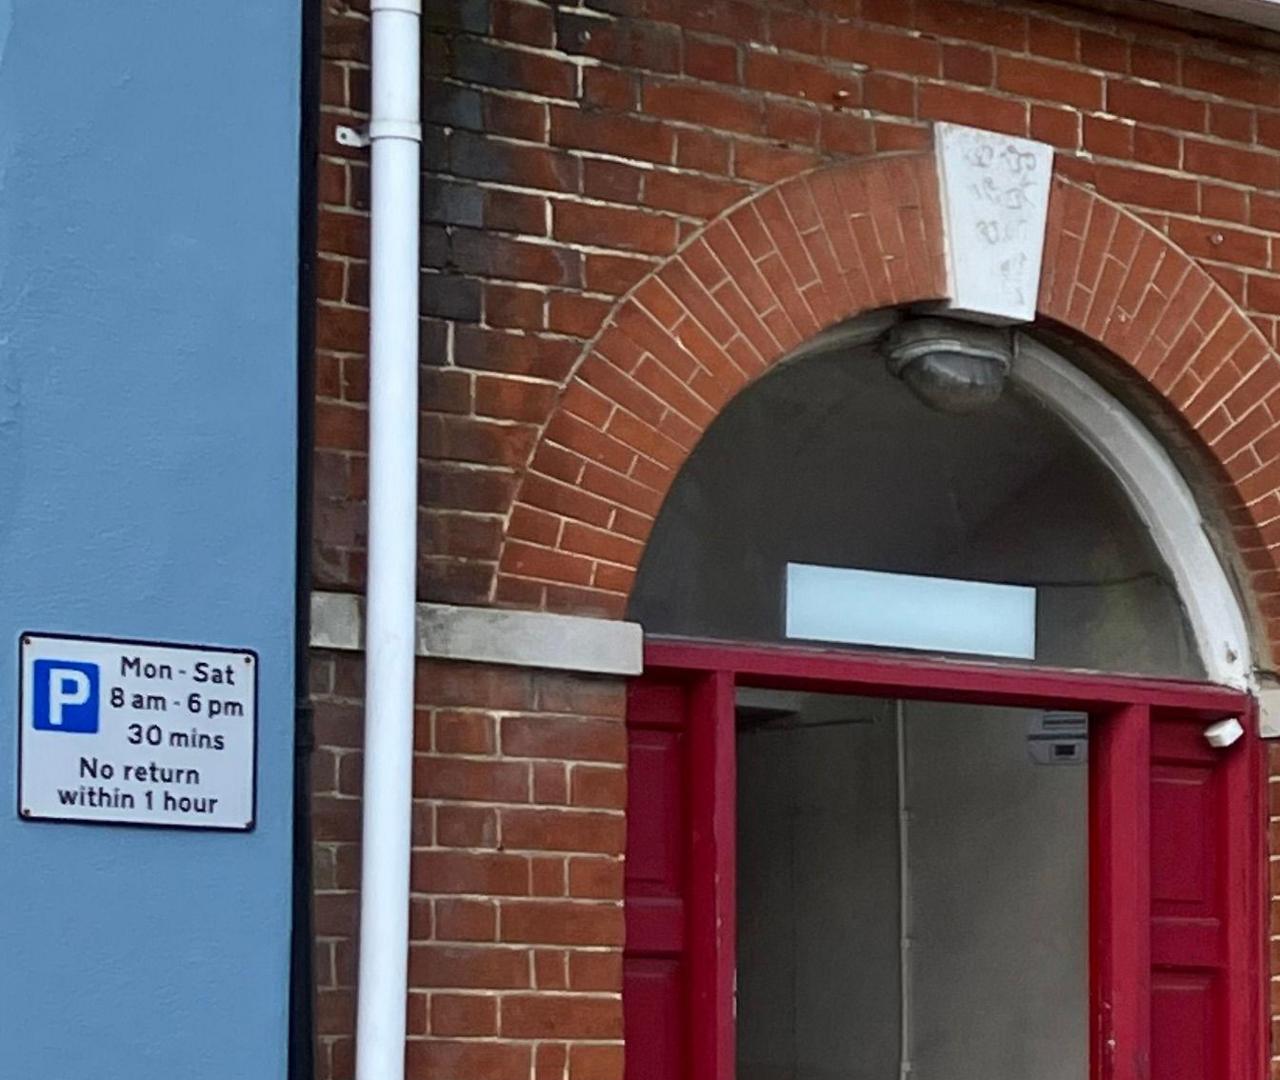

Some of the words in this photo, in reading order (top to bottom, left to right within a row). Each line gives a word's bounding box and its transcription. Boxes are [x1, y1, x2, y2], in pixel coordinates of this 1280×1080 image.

[120, 656, 173, 680] Mon
[193, 662, 235, 685] Sat
[49, 669, 91, 726] P
[128, 723, 162, 745] 30
[169, 728, 225, 750] mins
[80, 757, 114, 779] No
[123, 761, 200, 784] return
[57, 786, 135, 809] within
[144, 790, 154, 809] 1
[163, 791, 218, 814] hour
